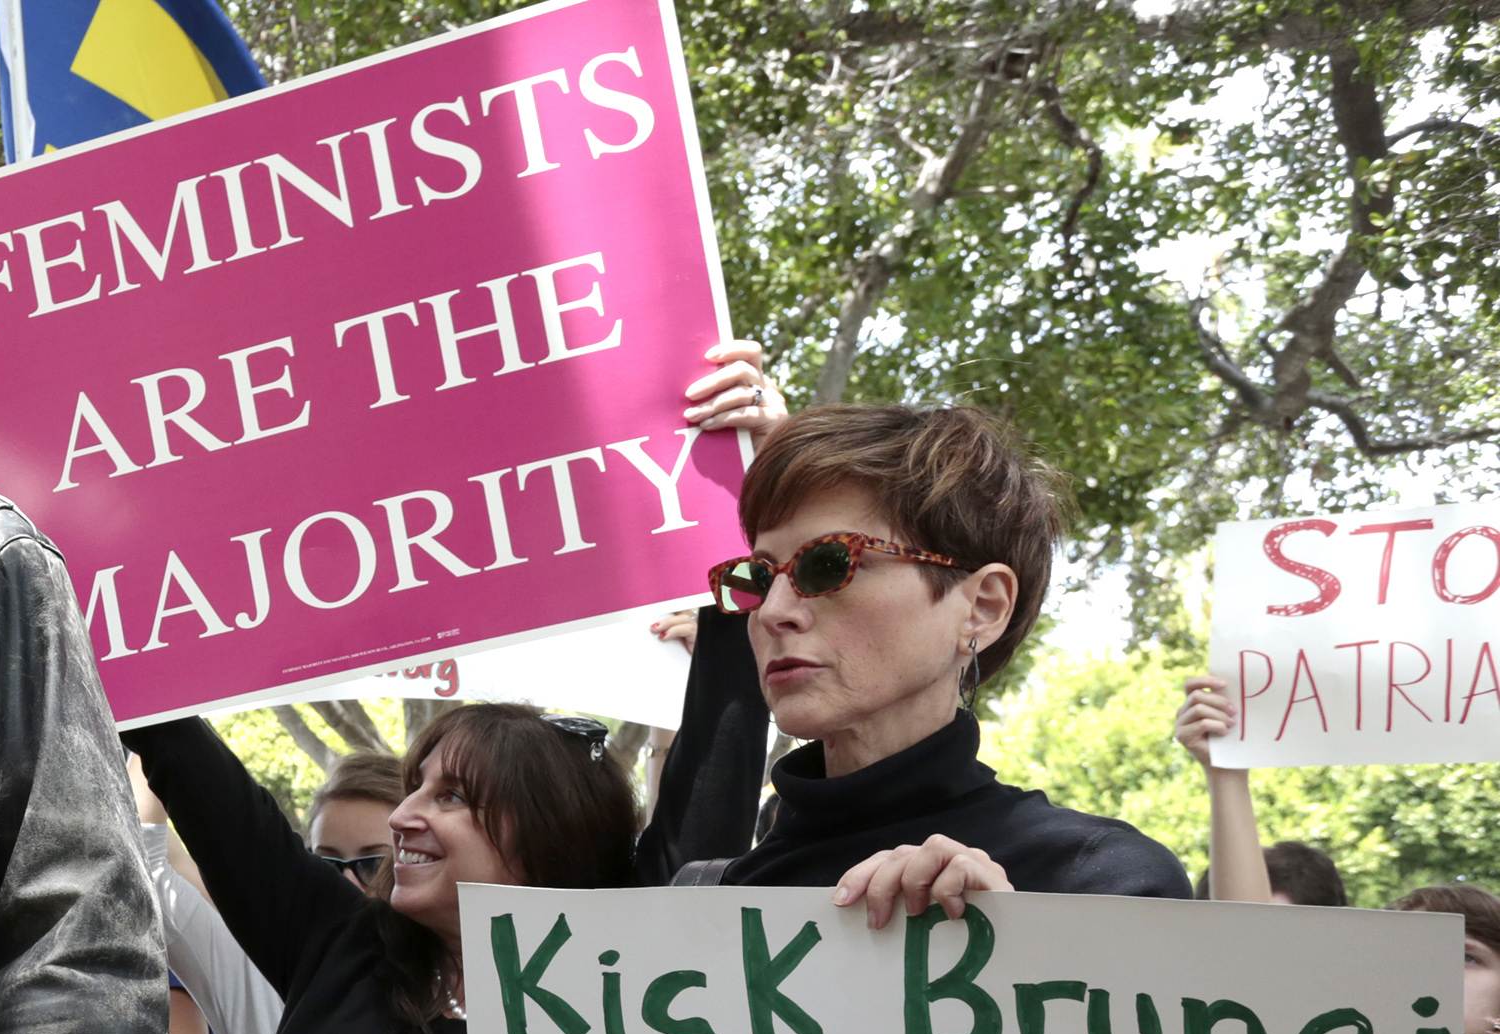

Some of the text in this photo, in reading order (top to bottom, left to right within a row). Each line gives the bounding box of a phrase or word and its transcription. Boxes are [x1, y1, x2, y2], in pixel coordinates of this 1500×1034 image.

[53, 252, 623, 492] ARE THE
[1264, 518, 1500, 617] STO
[1239, 638, 1500, 742] PATRIA
